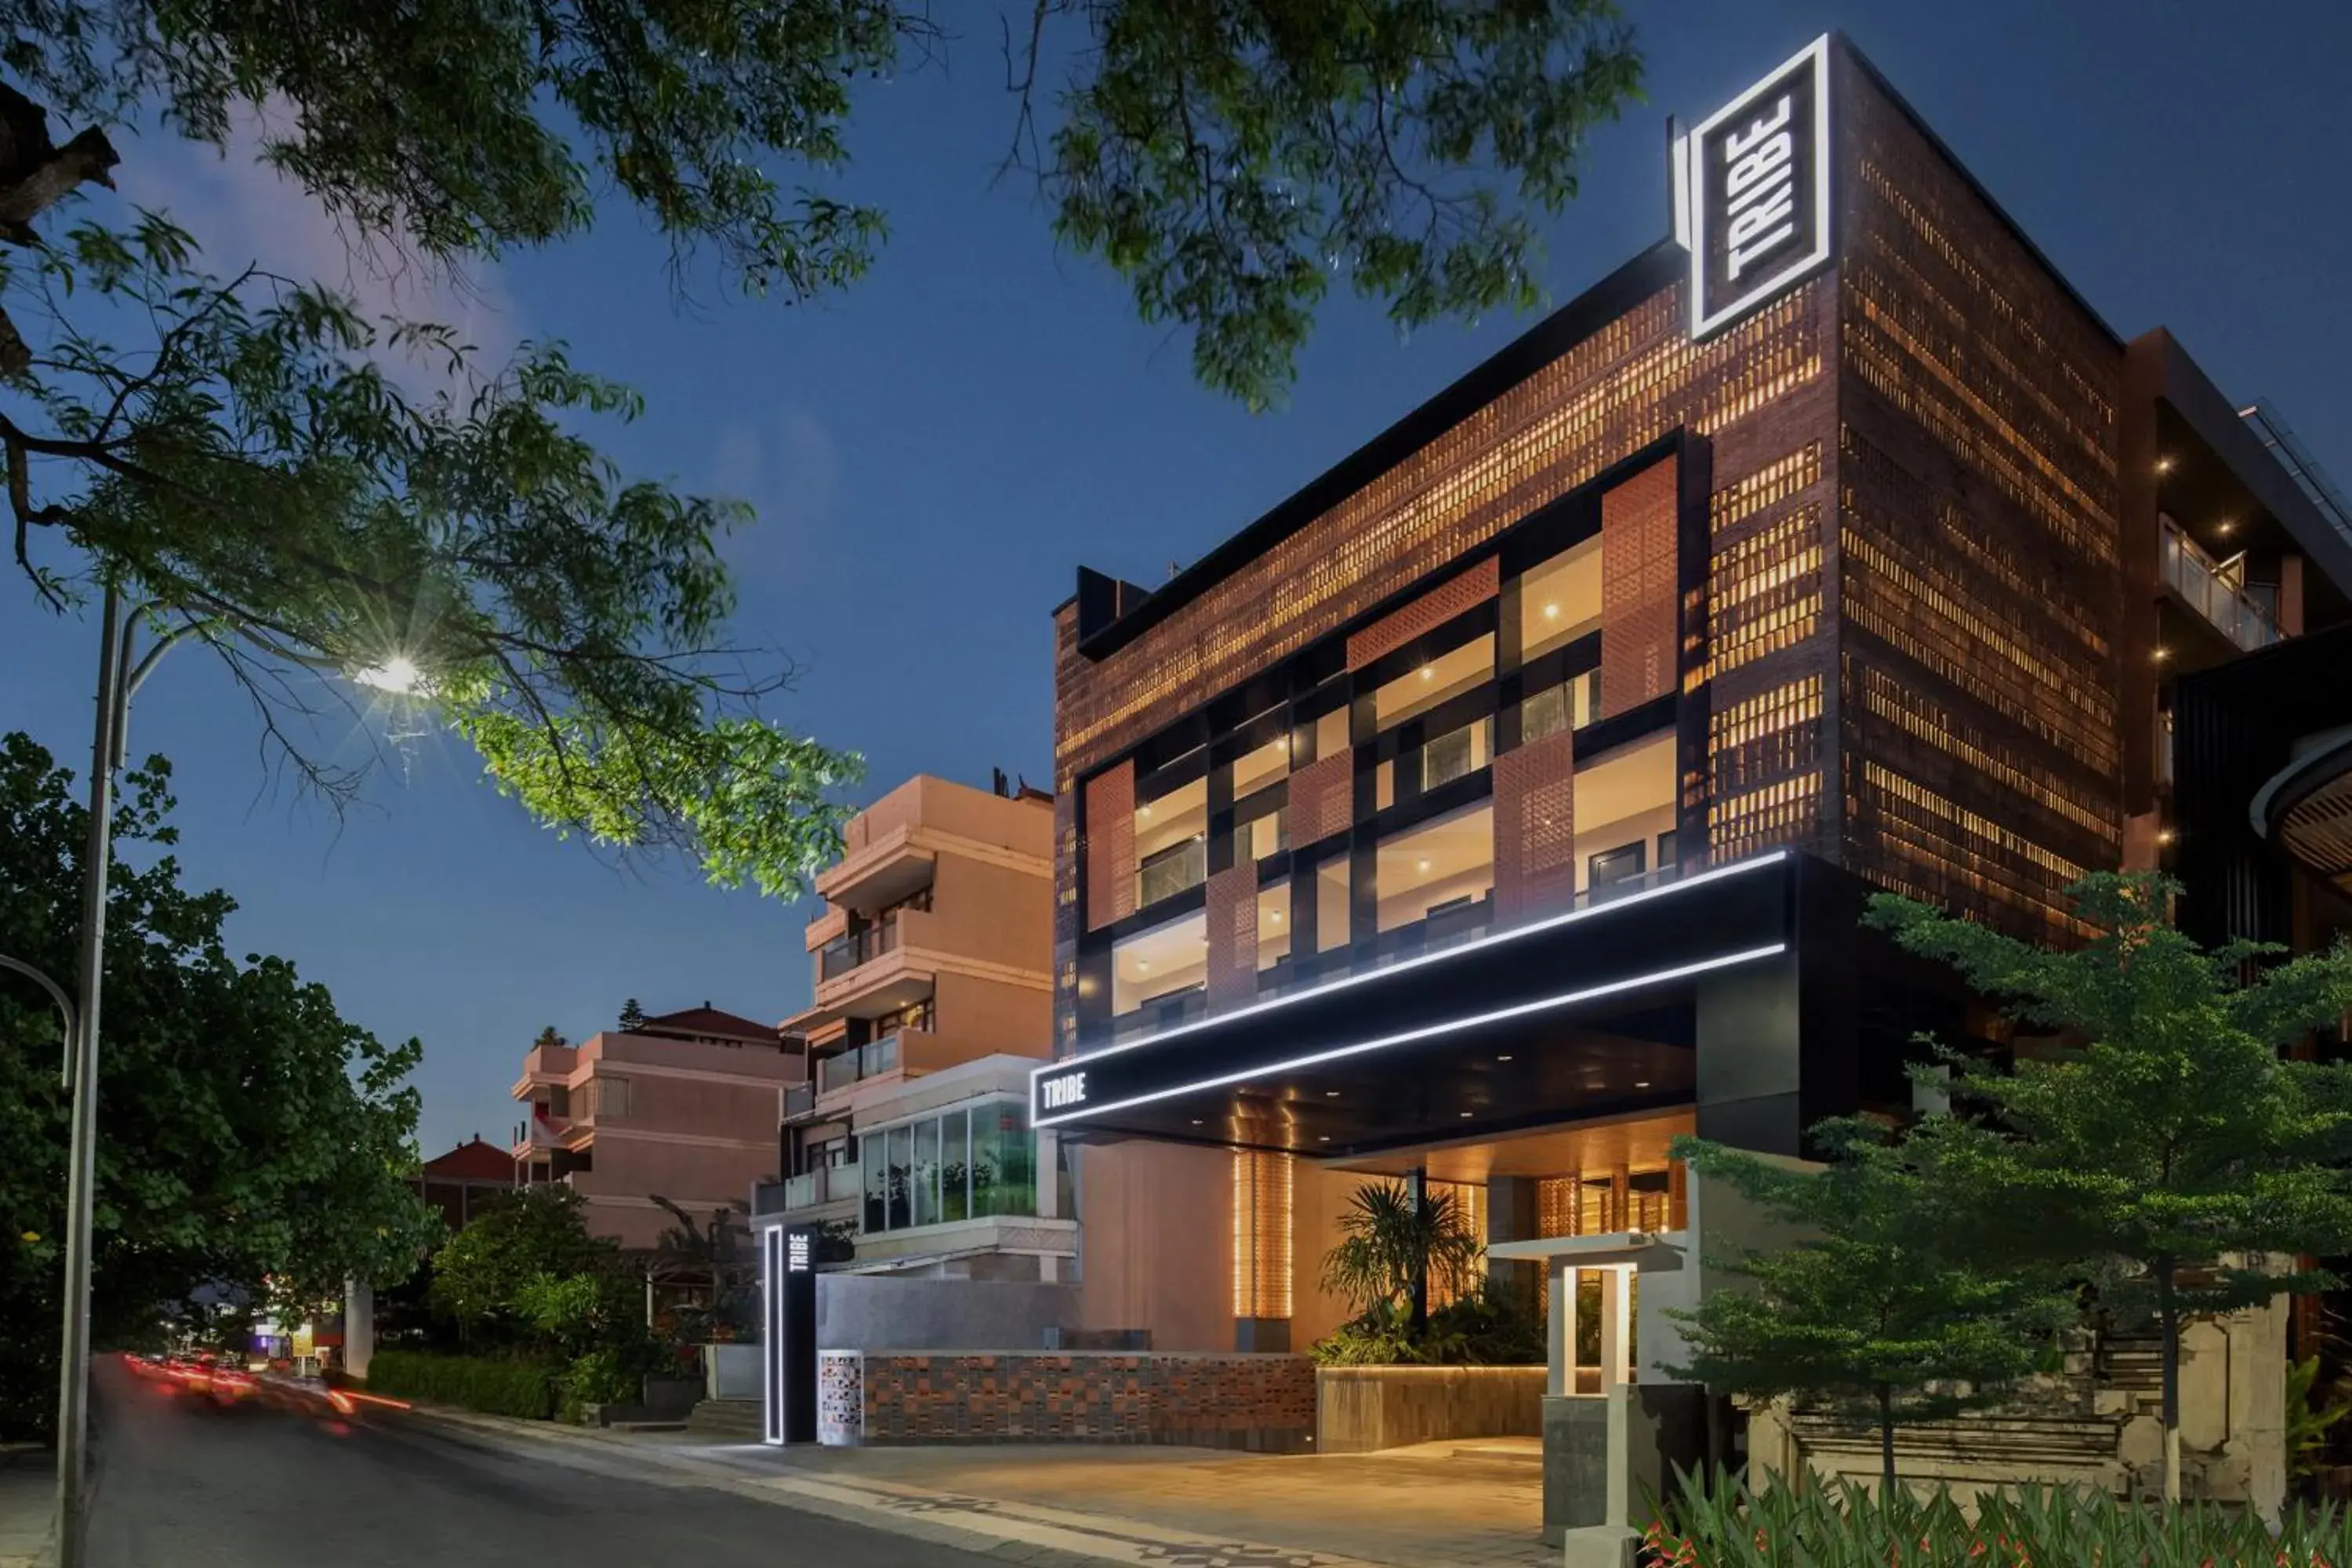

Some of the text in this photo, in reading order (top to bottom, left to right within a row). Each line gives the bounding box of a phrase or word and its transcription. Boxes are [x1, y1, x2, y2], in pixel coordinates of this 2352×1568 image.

[1726, 94, 1793, 281] TRIBE
[1042, 1072, 1086, 1109] TRIBE
[789, 1232, 808, 1272] TRIBE
